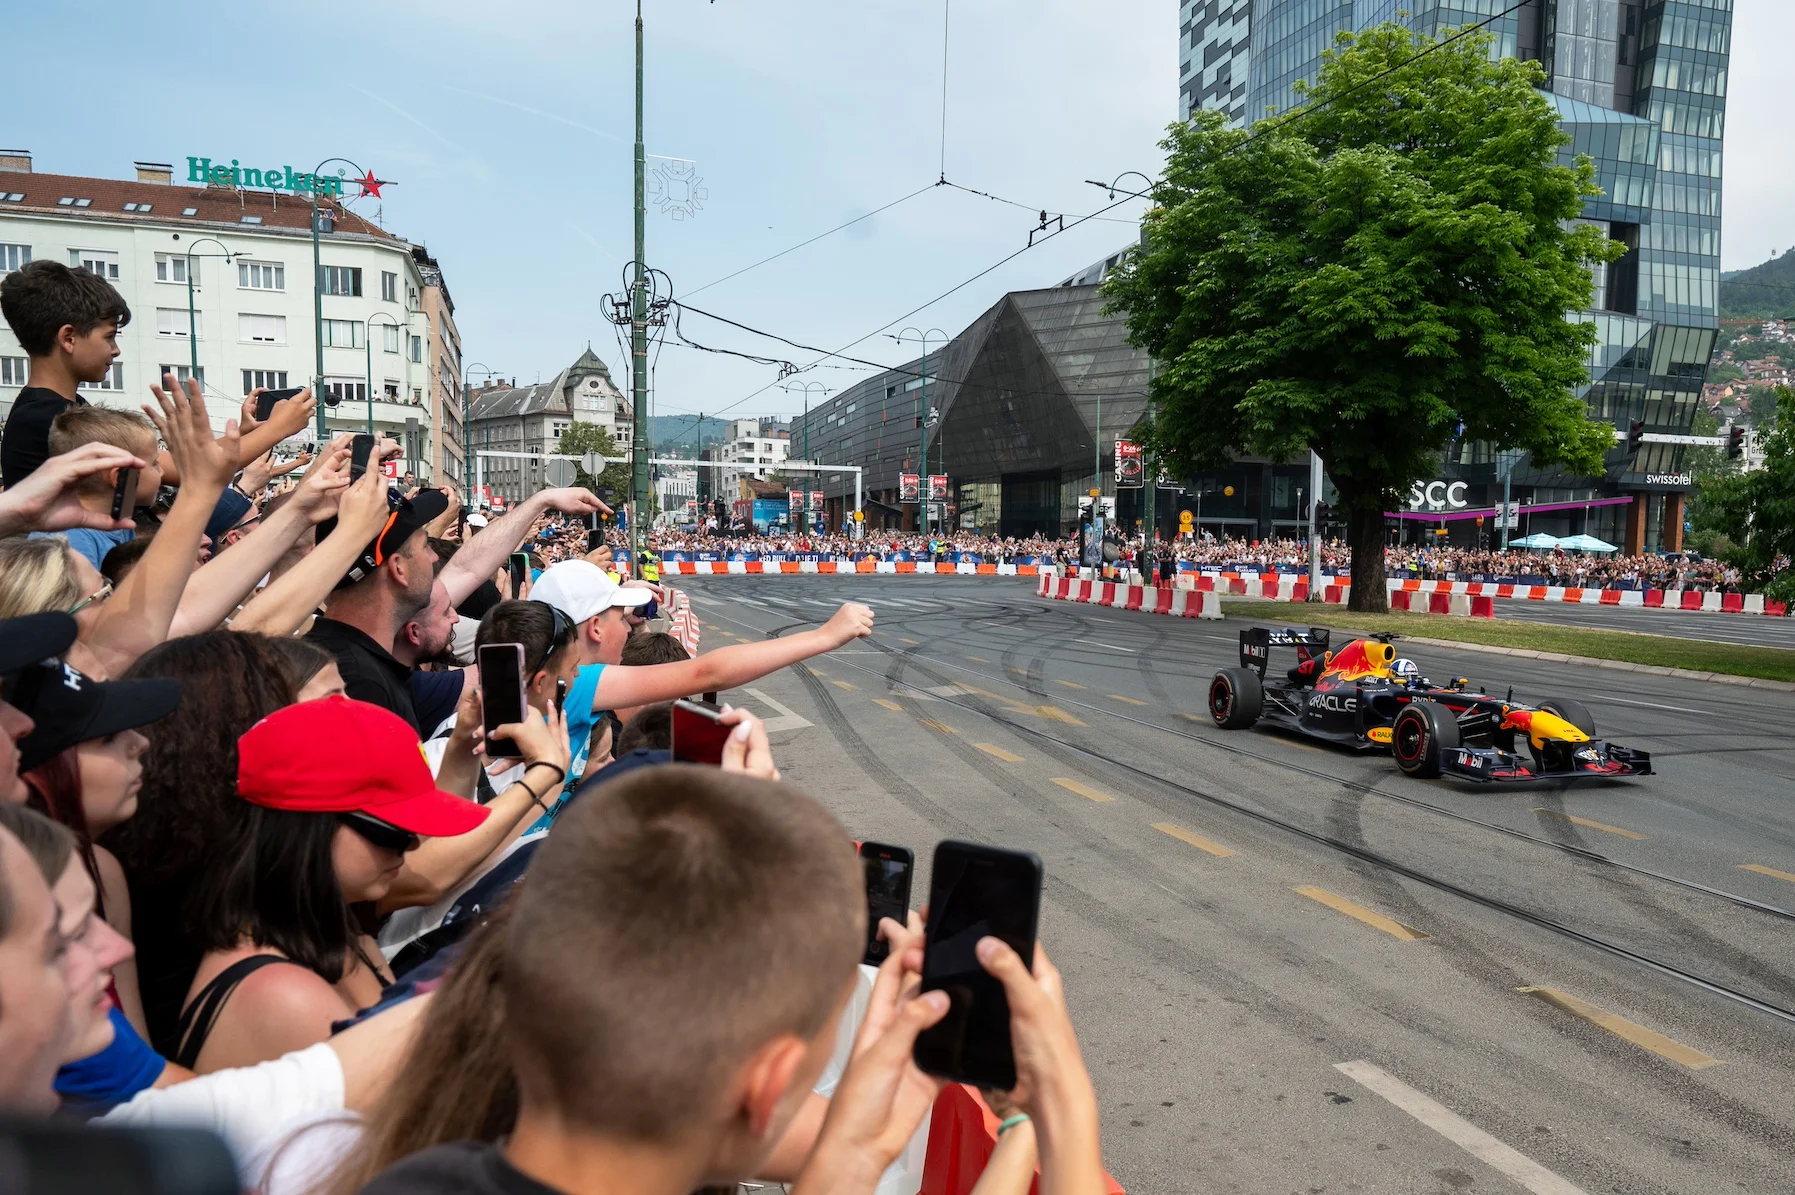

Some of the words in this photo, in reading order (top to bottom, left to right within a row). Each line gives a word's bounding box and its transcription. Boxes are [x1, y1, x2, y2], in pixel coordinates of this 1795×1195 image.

[186, 156, 344, 195] Heineken
[1646, 470, 1692, 485] swissôtel
[1408, 480, 1469, 508] SCC
[1243, 643, 1259, 657] Mobil
[1309, 694, 1357, 713] ORACLE
[1458, 751, 1484, 769] Mobil
